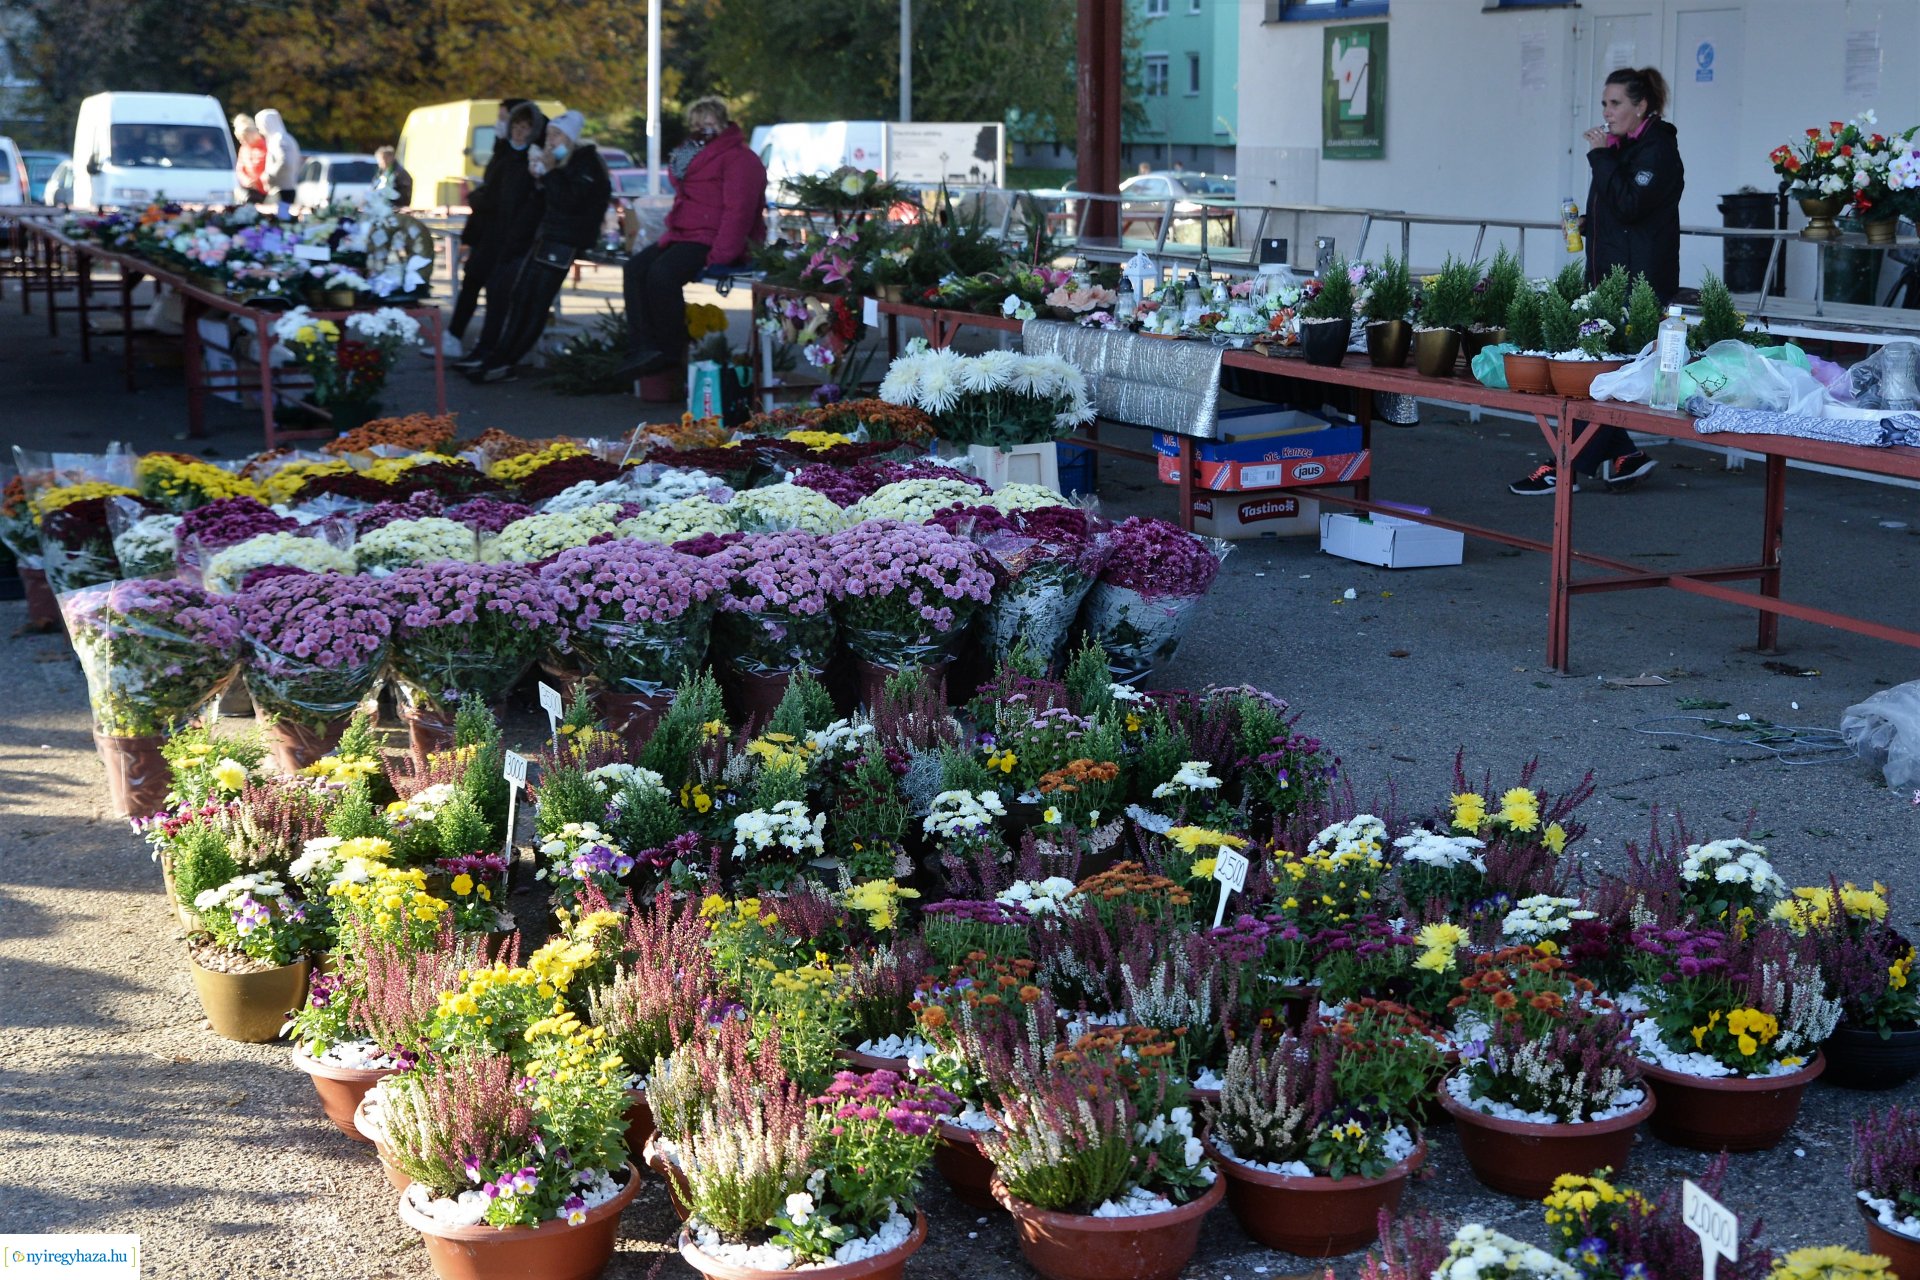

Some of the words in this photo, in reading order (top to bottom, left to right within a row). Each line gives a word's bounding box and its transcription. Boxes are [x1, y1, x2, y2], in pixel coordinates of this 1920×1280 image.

[1298, 464, 1320, 479] jaus
[1241, 503, 1286, 518] Tastino
[1218, 850, 1245, 886] 2500
[1689, 1195, 1731, 1247] 2000
